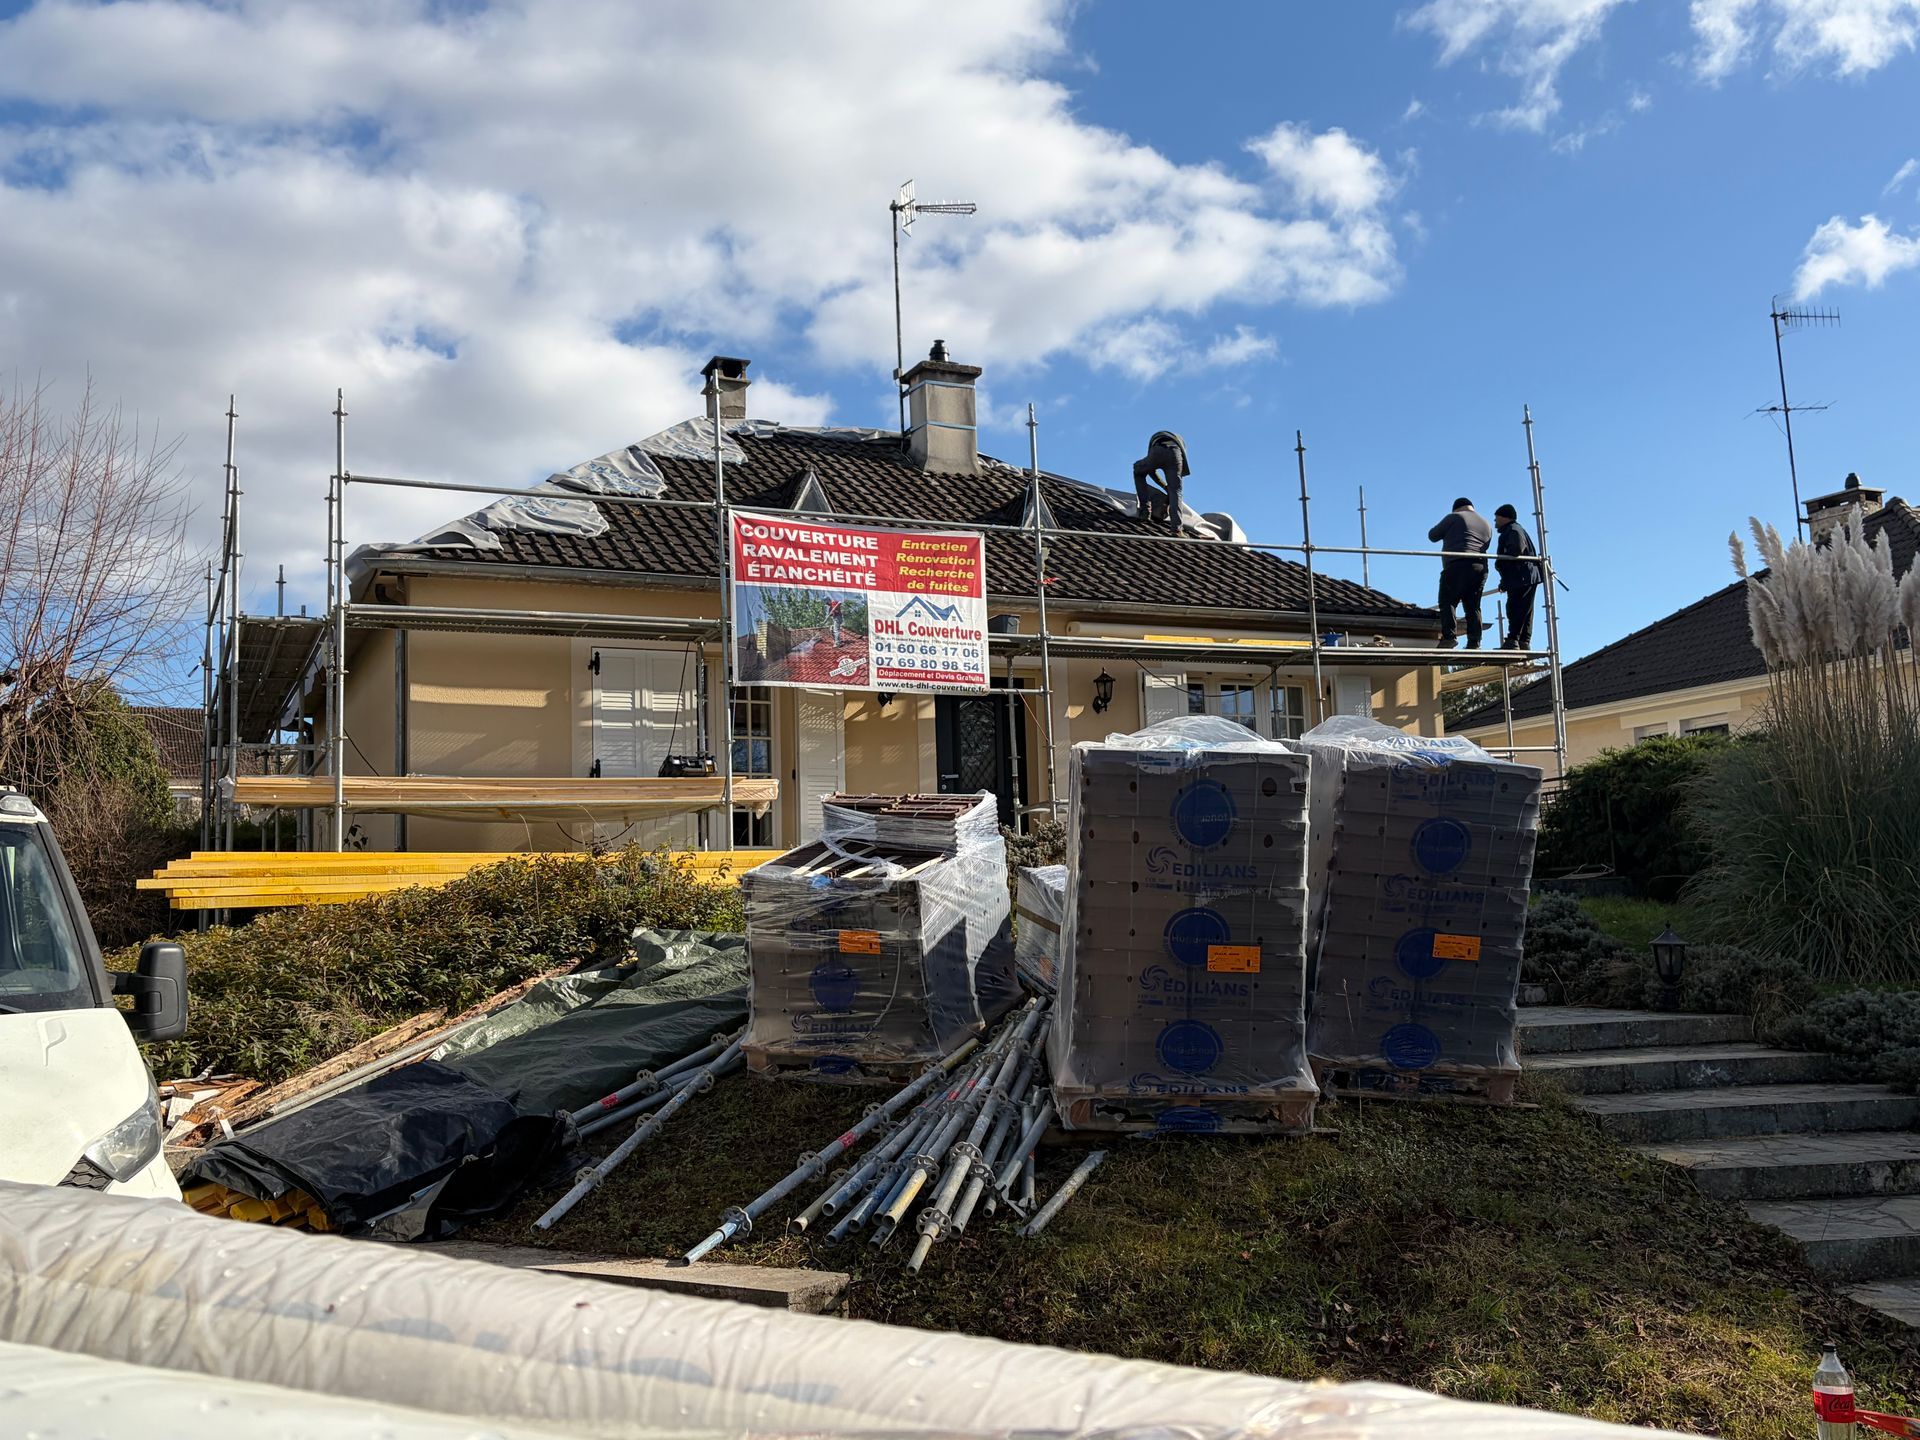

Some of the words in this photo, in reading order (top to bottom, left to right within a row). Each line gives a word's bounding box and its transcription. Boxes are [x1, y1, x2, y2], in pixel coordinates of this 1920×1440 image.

[740, 524, 879, 550] COUVERTURE
[901, 539, 968, 552] Entretien
[743, 543, 879, 568] RAVALEMENT
[895, 552, 976, 566] Rénovation
[747, 561, 877, 586] ÉTANCHÉITÉ
[898, 565, 975, 579] Recherche
[907, 580, 925, 590] de
[929, 580, 969, 593] fuites
[874, 619, 904, 636] DHL
[908, 621, 982, 641] Couverture
[875, 642, 892, 653] 01
[897, 643, 915, 654] 60
[920, 644, 937, 656] 66
[941, 646, 958, 657] 17
[962, 648, 979, 659] 06
[875, 656, 893, 667] 07
[898, 657, 916, 668] 69
[920, 659, 937, 670] 80
[942, 660, 959, 671] 98
[963, 662, 980, 673] 54
[879, 669, 926, 679] Déplacement
[927, 671, 934, 679] et
[935, 672, 955, 681] Devis
[956, 674, 984, 682] Gratuits
[877, 681, 985, 694] www.ets-dhl-couverture.fr
[1172, 863, 1258, 880] EDILIANS
[1407, 888, 1485, 903] EDILIANS
[1164, 978, 1249, 997] EDILIANS
[1157, 1084, 1248, 1094] EDILIANS
